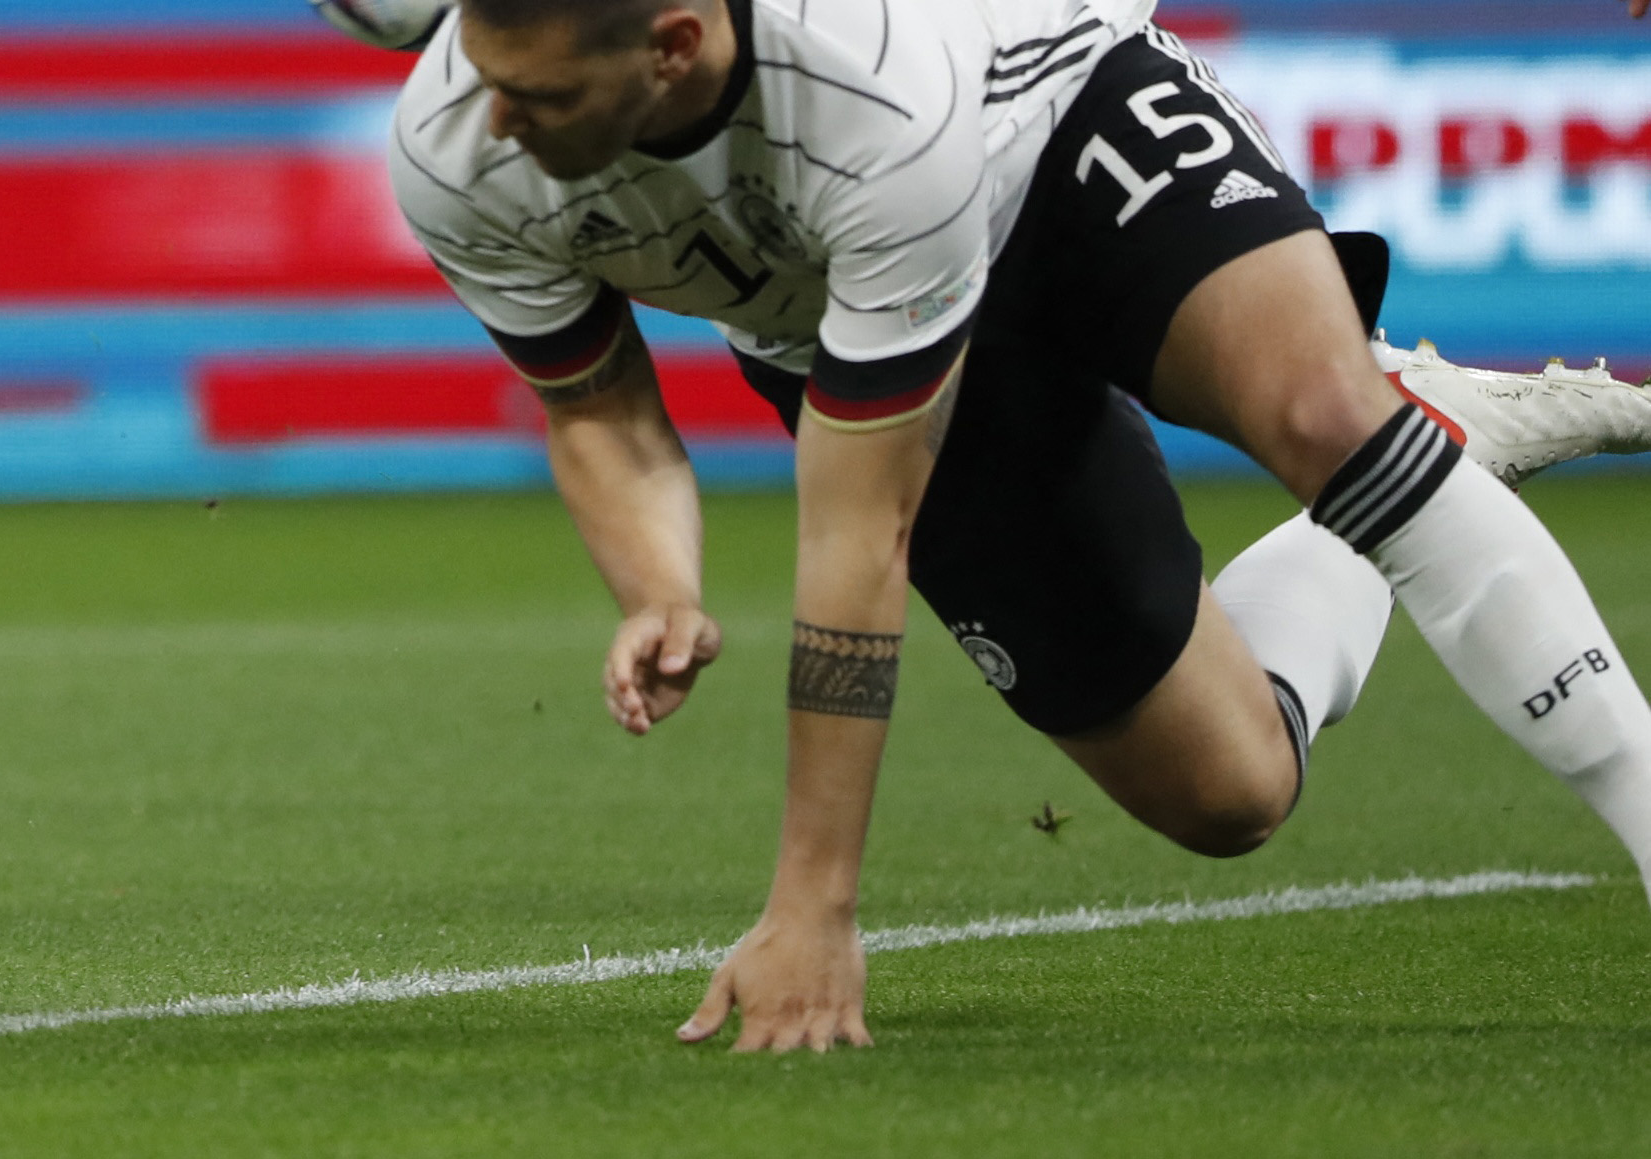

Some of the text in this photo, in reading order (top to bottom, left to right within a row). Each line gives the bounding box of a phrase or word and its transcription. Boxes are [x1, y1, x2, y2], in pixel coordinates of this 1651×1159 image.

[1075, 81, 1233, 228] 15
[1210, 186, 1279, 209] adidas
[1523, 647, 1610, 719] DFB
